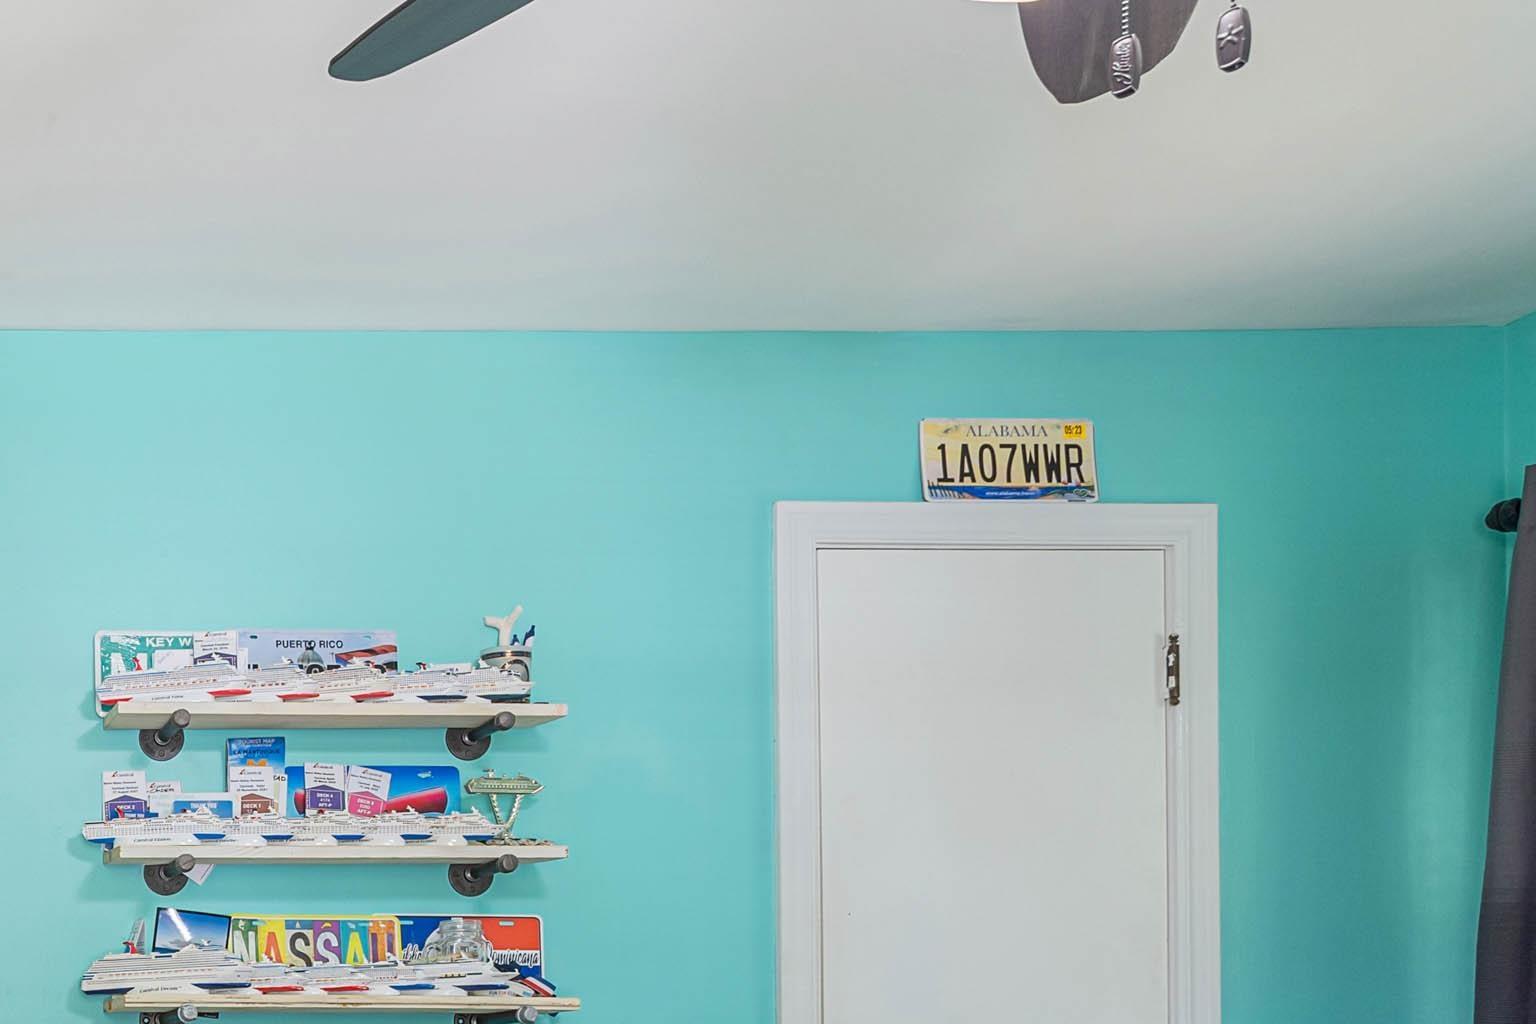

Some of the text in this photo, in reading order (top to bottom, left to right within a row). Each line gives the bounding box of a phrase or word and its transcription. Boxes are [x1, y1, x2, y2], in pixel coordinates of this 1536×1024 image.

[966, 425, 1048, 437] ALABAMA
[937, 443, 1085, 483] 1A07WWR
[146, 637, 173, 647] KEY
[275, 639, 344, 648] PUERTO RICO
[233, 931, 395, 966] NASSAU
